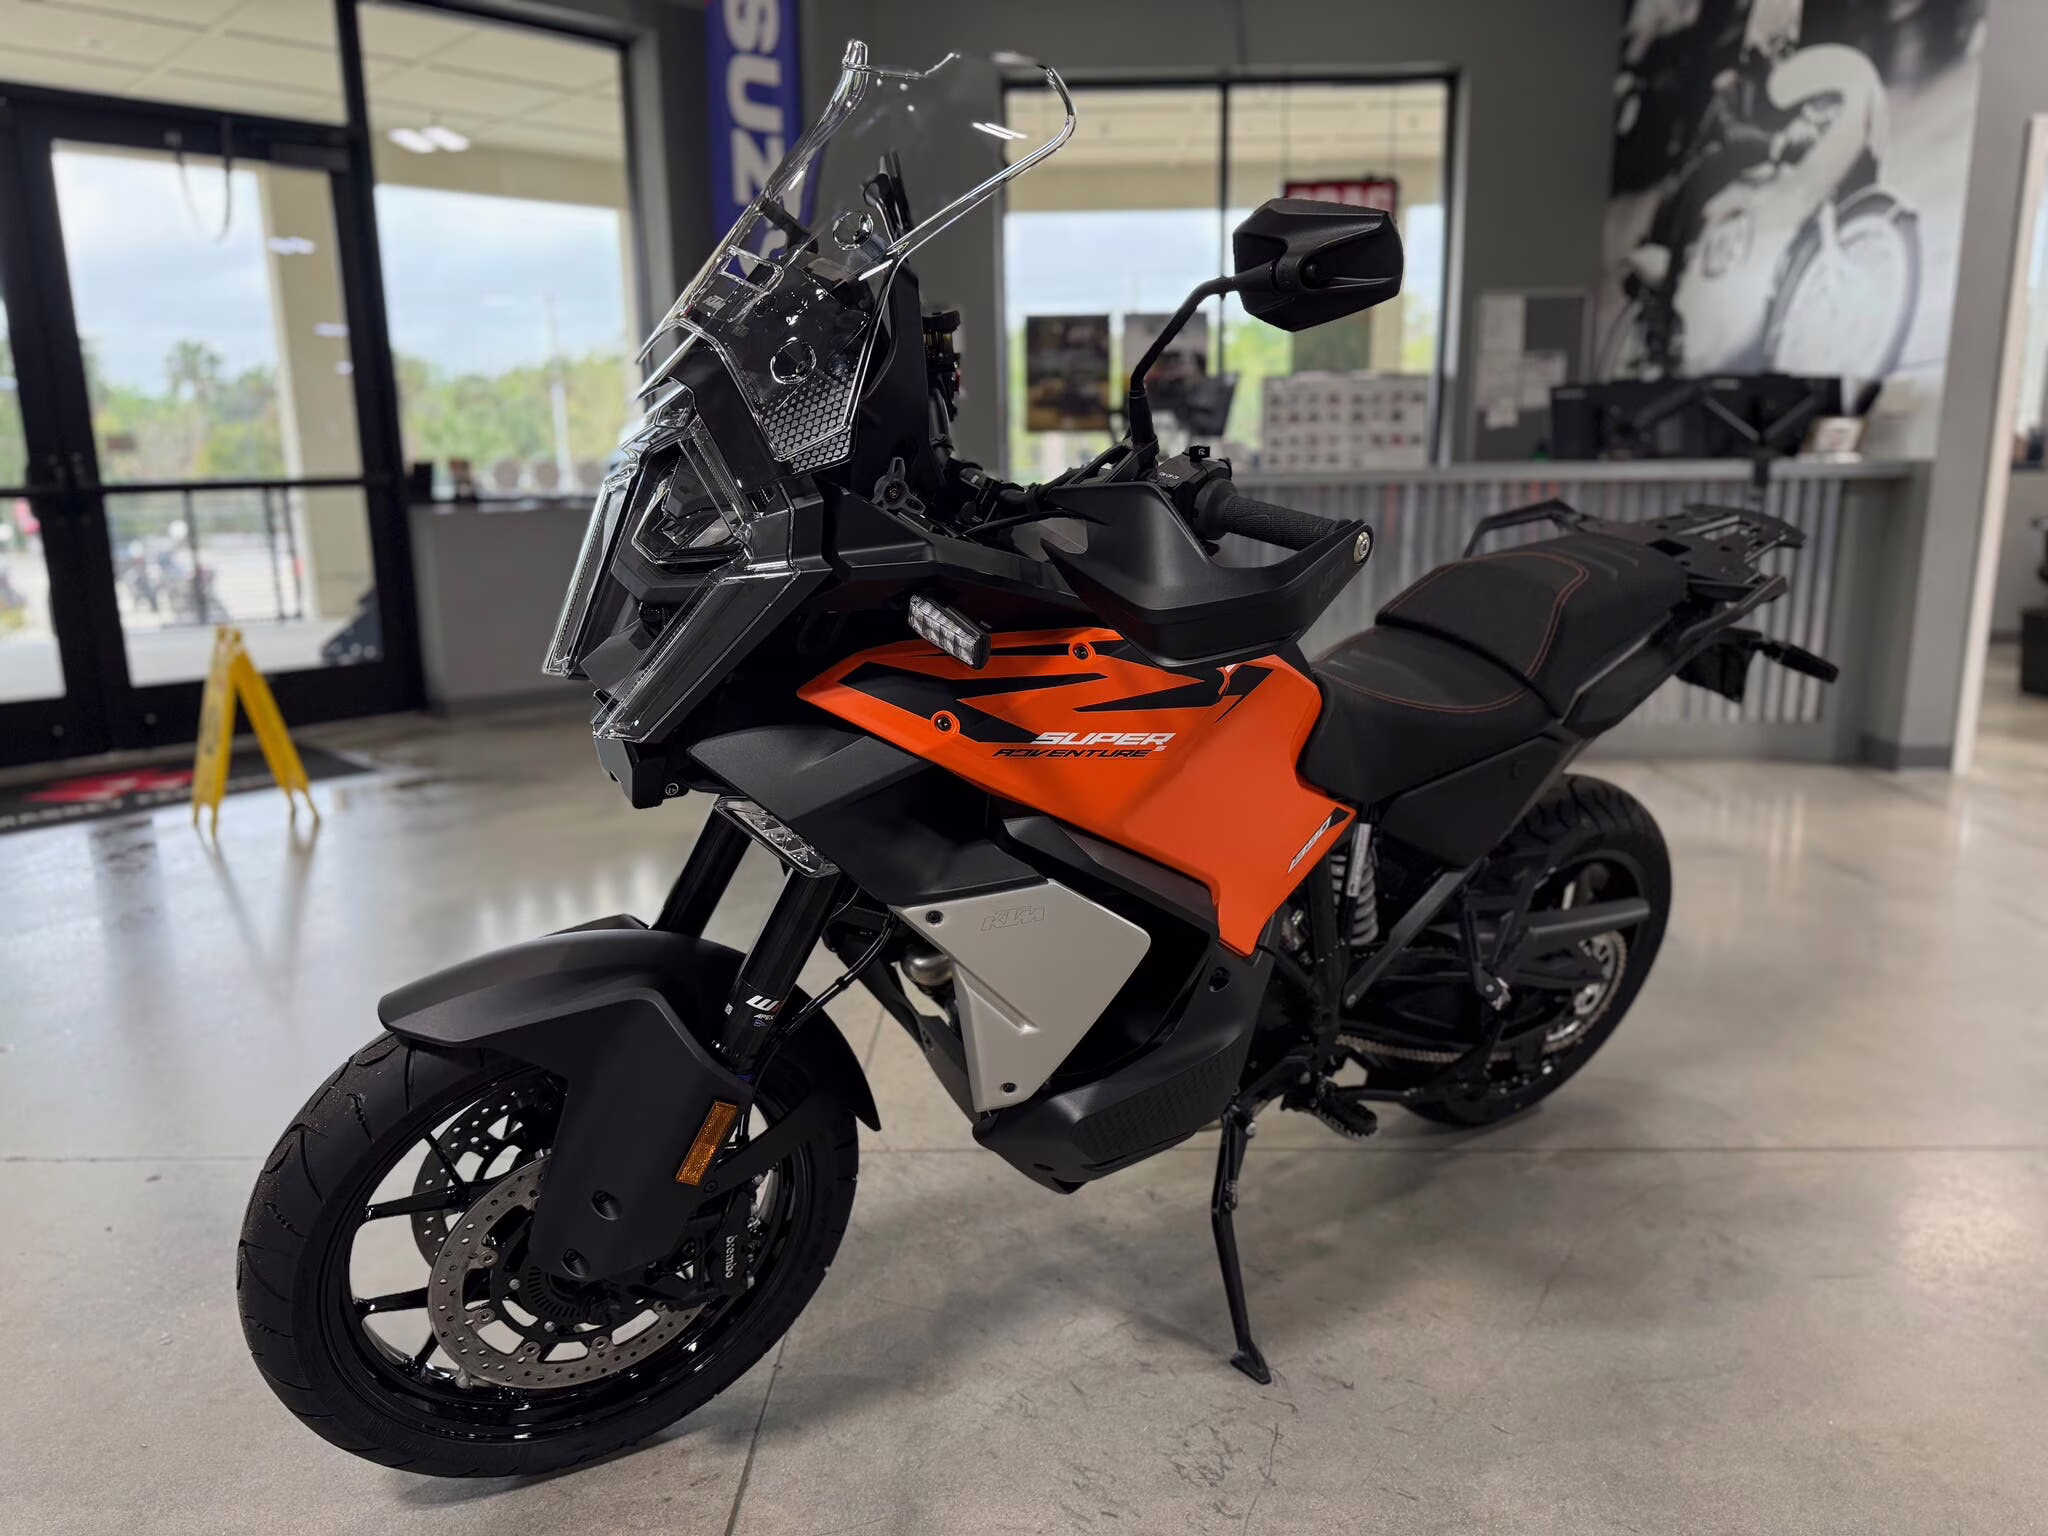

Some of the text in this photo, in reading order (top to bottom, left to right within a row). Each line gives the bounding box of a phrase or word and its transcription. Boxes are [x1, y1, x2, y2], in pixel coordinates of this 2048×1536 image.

[1030, 731, 1176, 745] SUPER
[992, 748, 1153, 758] ADVENTURE
[724, 1234, 738, 1278] brembo
